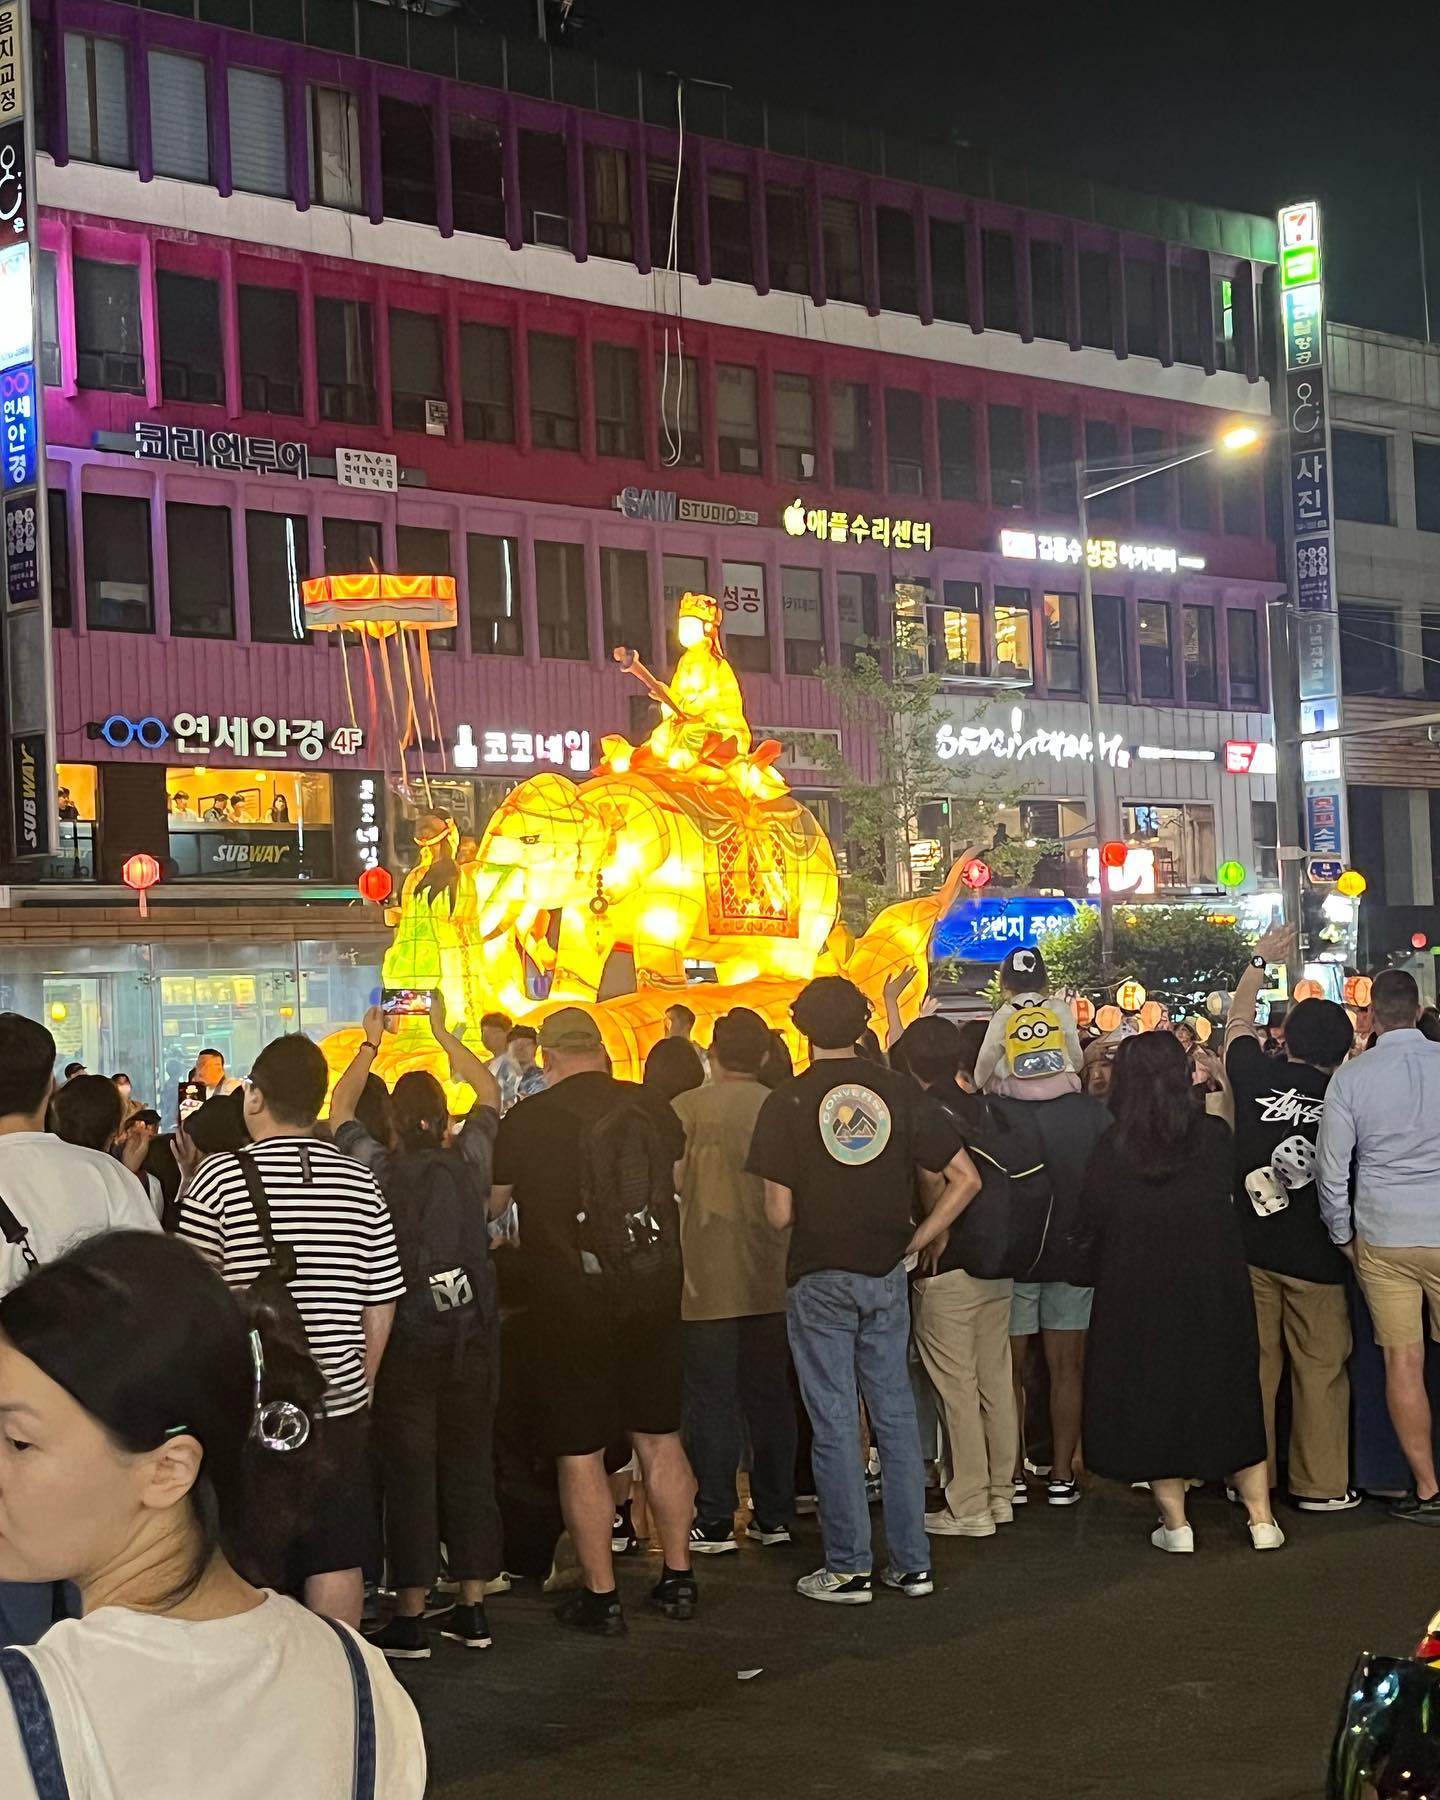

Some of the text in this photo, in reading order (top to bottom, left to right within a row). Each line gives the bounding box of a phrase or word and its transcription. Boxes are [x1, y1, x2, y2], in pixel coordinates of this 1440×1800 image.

[134, 421, 309, 480] 코리언투어
[1296, 455, 1323, 518] 사진
[681, 502, 739, 523] STUDIO
[806, 509, 931, 552] 애플수리센터
[723, 585, 761, 613] 성공
[173, 713, 363, 760] 연세안경 4F
[484, 730, 591, 771] 코코네일
[20, 742, 37, 849] SUBWAY
[213, 844, 290, 863] SUBWAY
